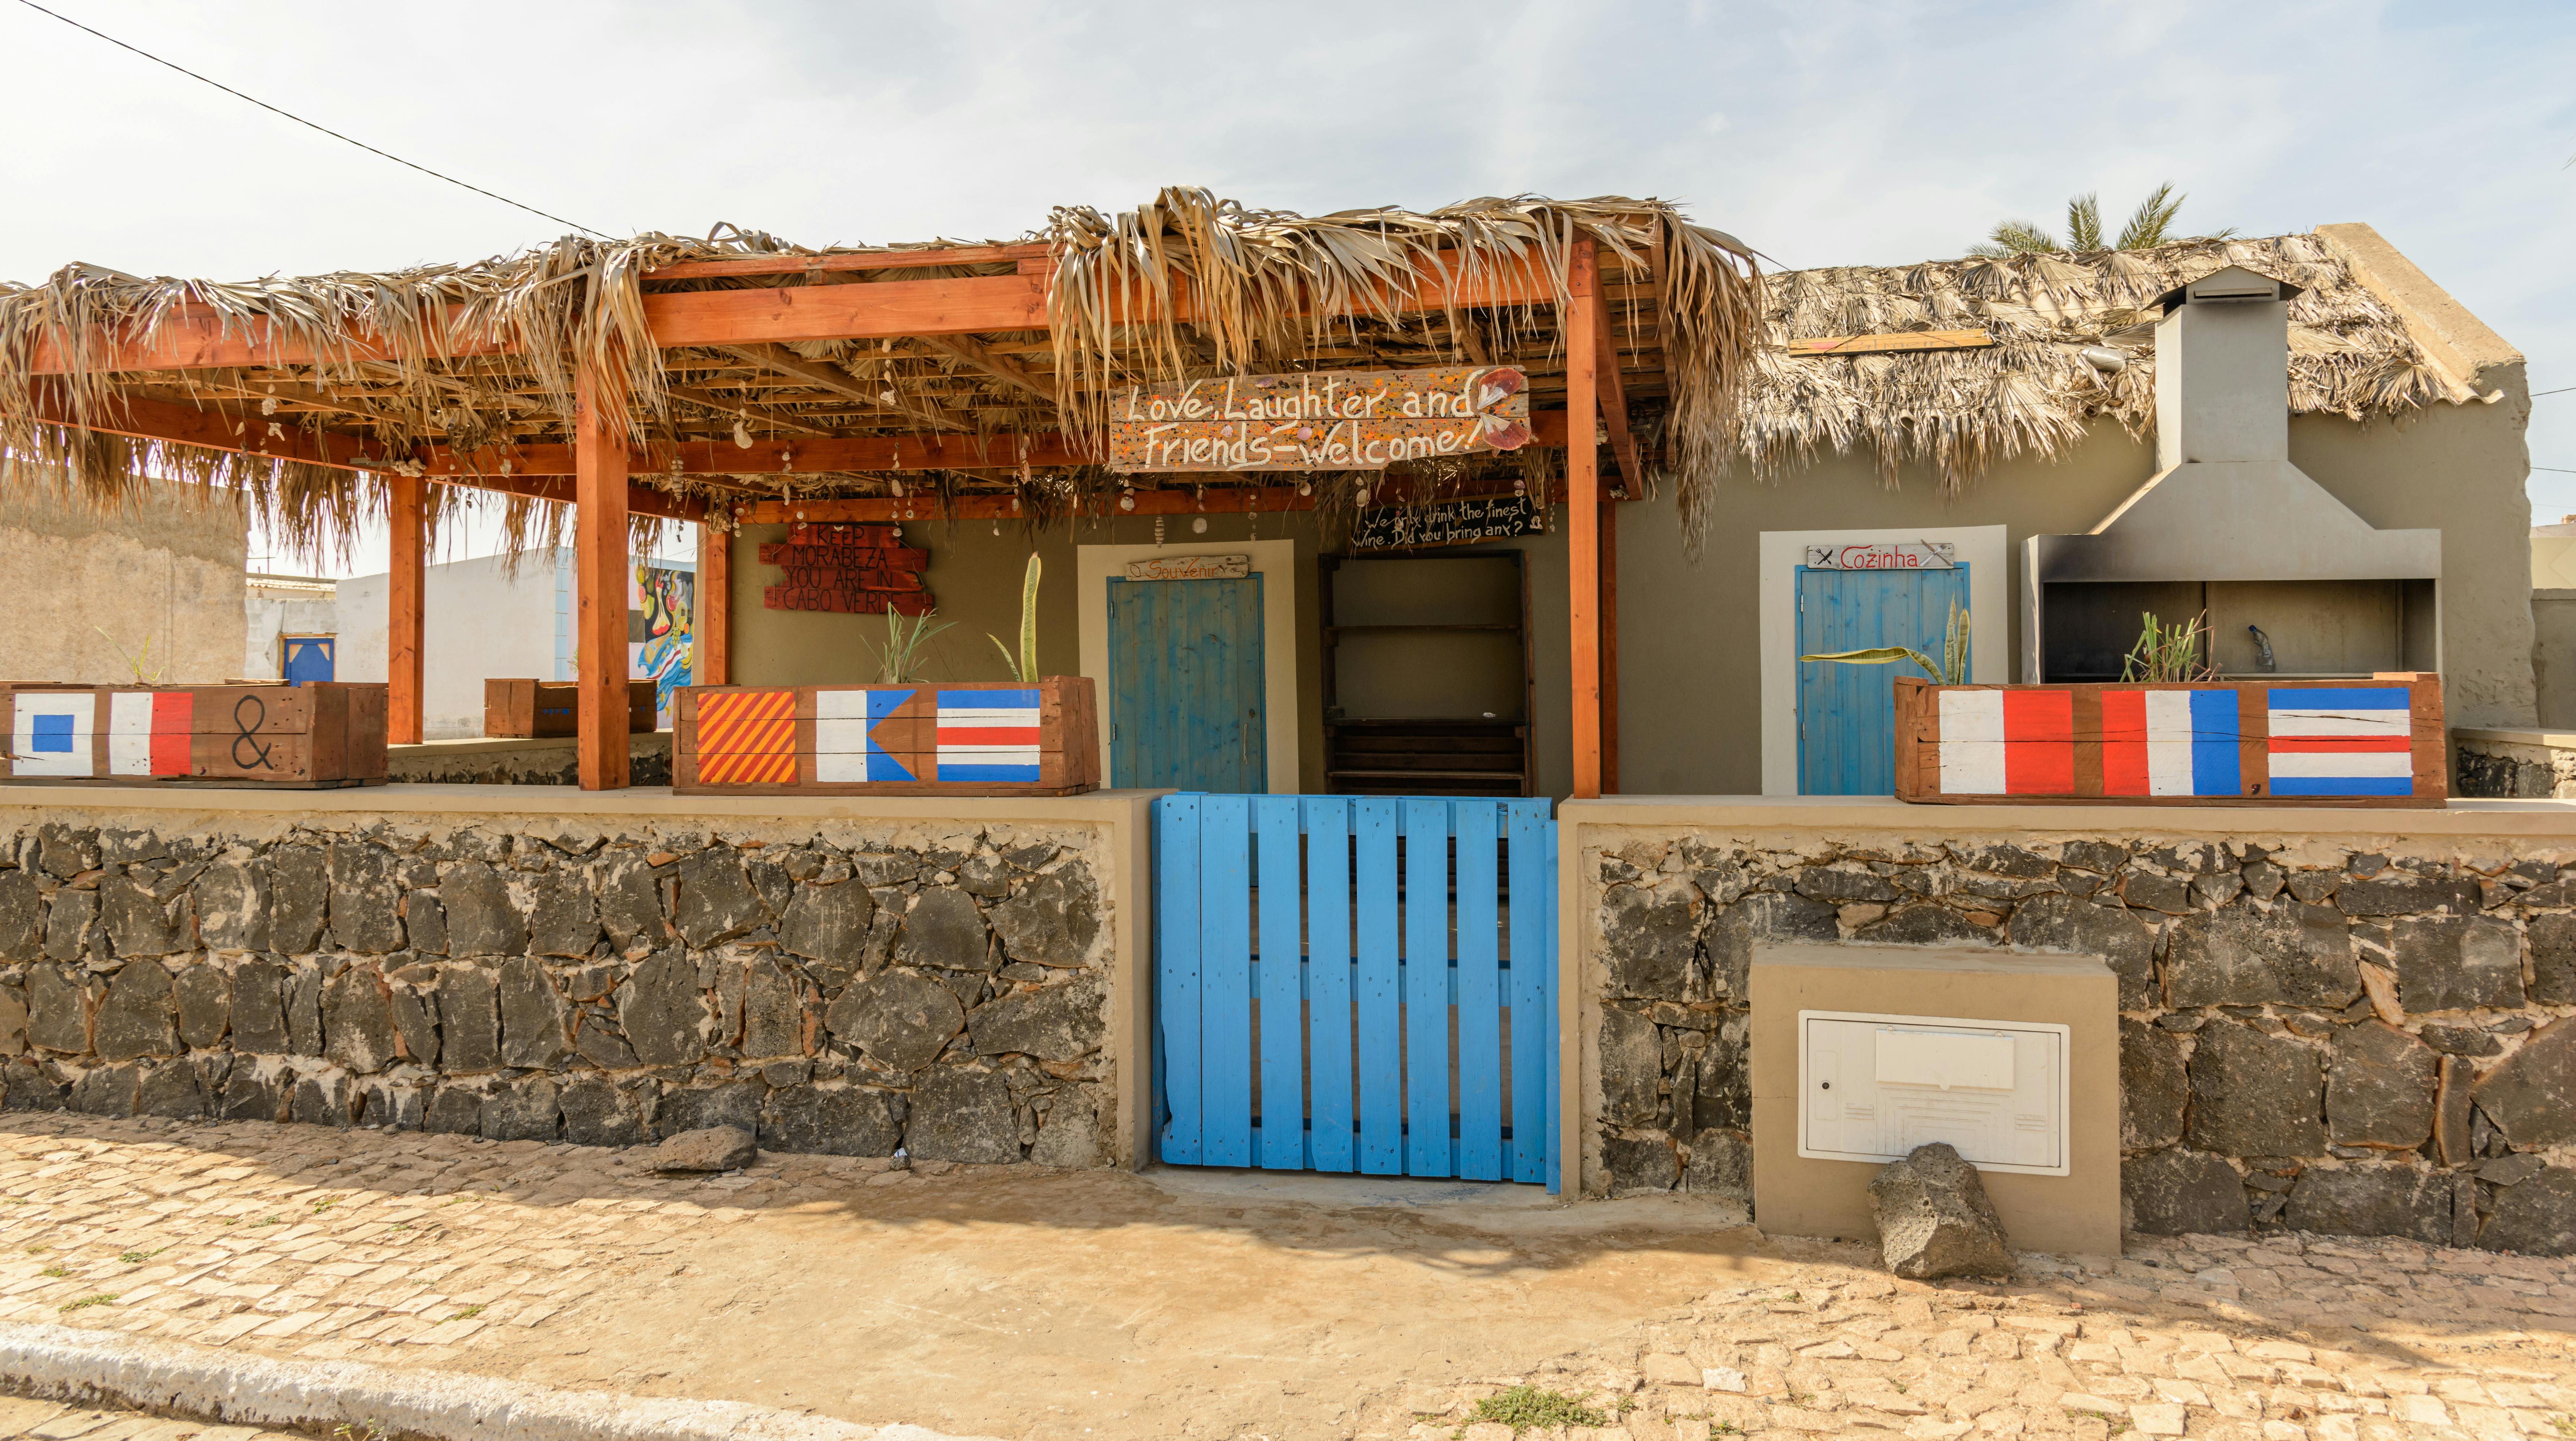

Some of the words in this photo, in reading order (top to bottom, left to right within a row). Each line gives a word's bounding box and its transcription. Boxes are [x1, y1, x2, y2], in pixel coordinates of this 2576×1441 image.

[1224, 374, 1387, 434] Laughter
[1403, 369, 1485, 418] and
[1459, 500, 1484, 521] the
[1485, 496, 1527, 523] finest
[817, 524, 865, 546] KEEP
[1419, 531, 1441, 542] you
[1446, 523, 1482, 545] bring
[792, 547, 888, 569] MORABEZA
[1145, 556, 1219, 579] Souvenir
[1840, 545, 1918, 569] Cozinha
[786, 567, 821, 588] YOU
[834, 569, 868, 591] ARE
[877, 570, 893, 588] IN
[783, 587, 832, 611] CABO
[841, 591, 902, 614] VERDE
[232, 694, 274, 770] &
